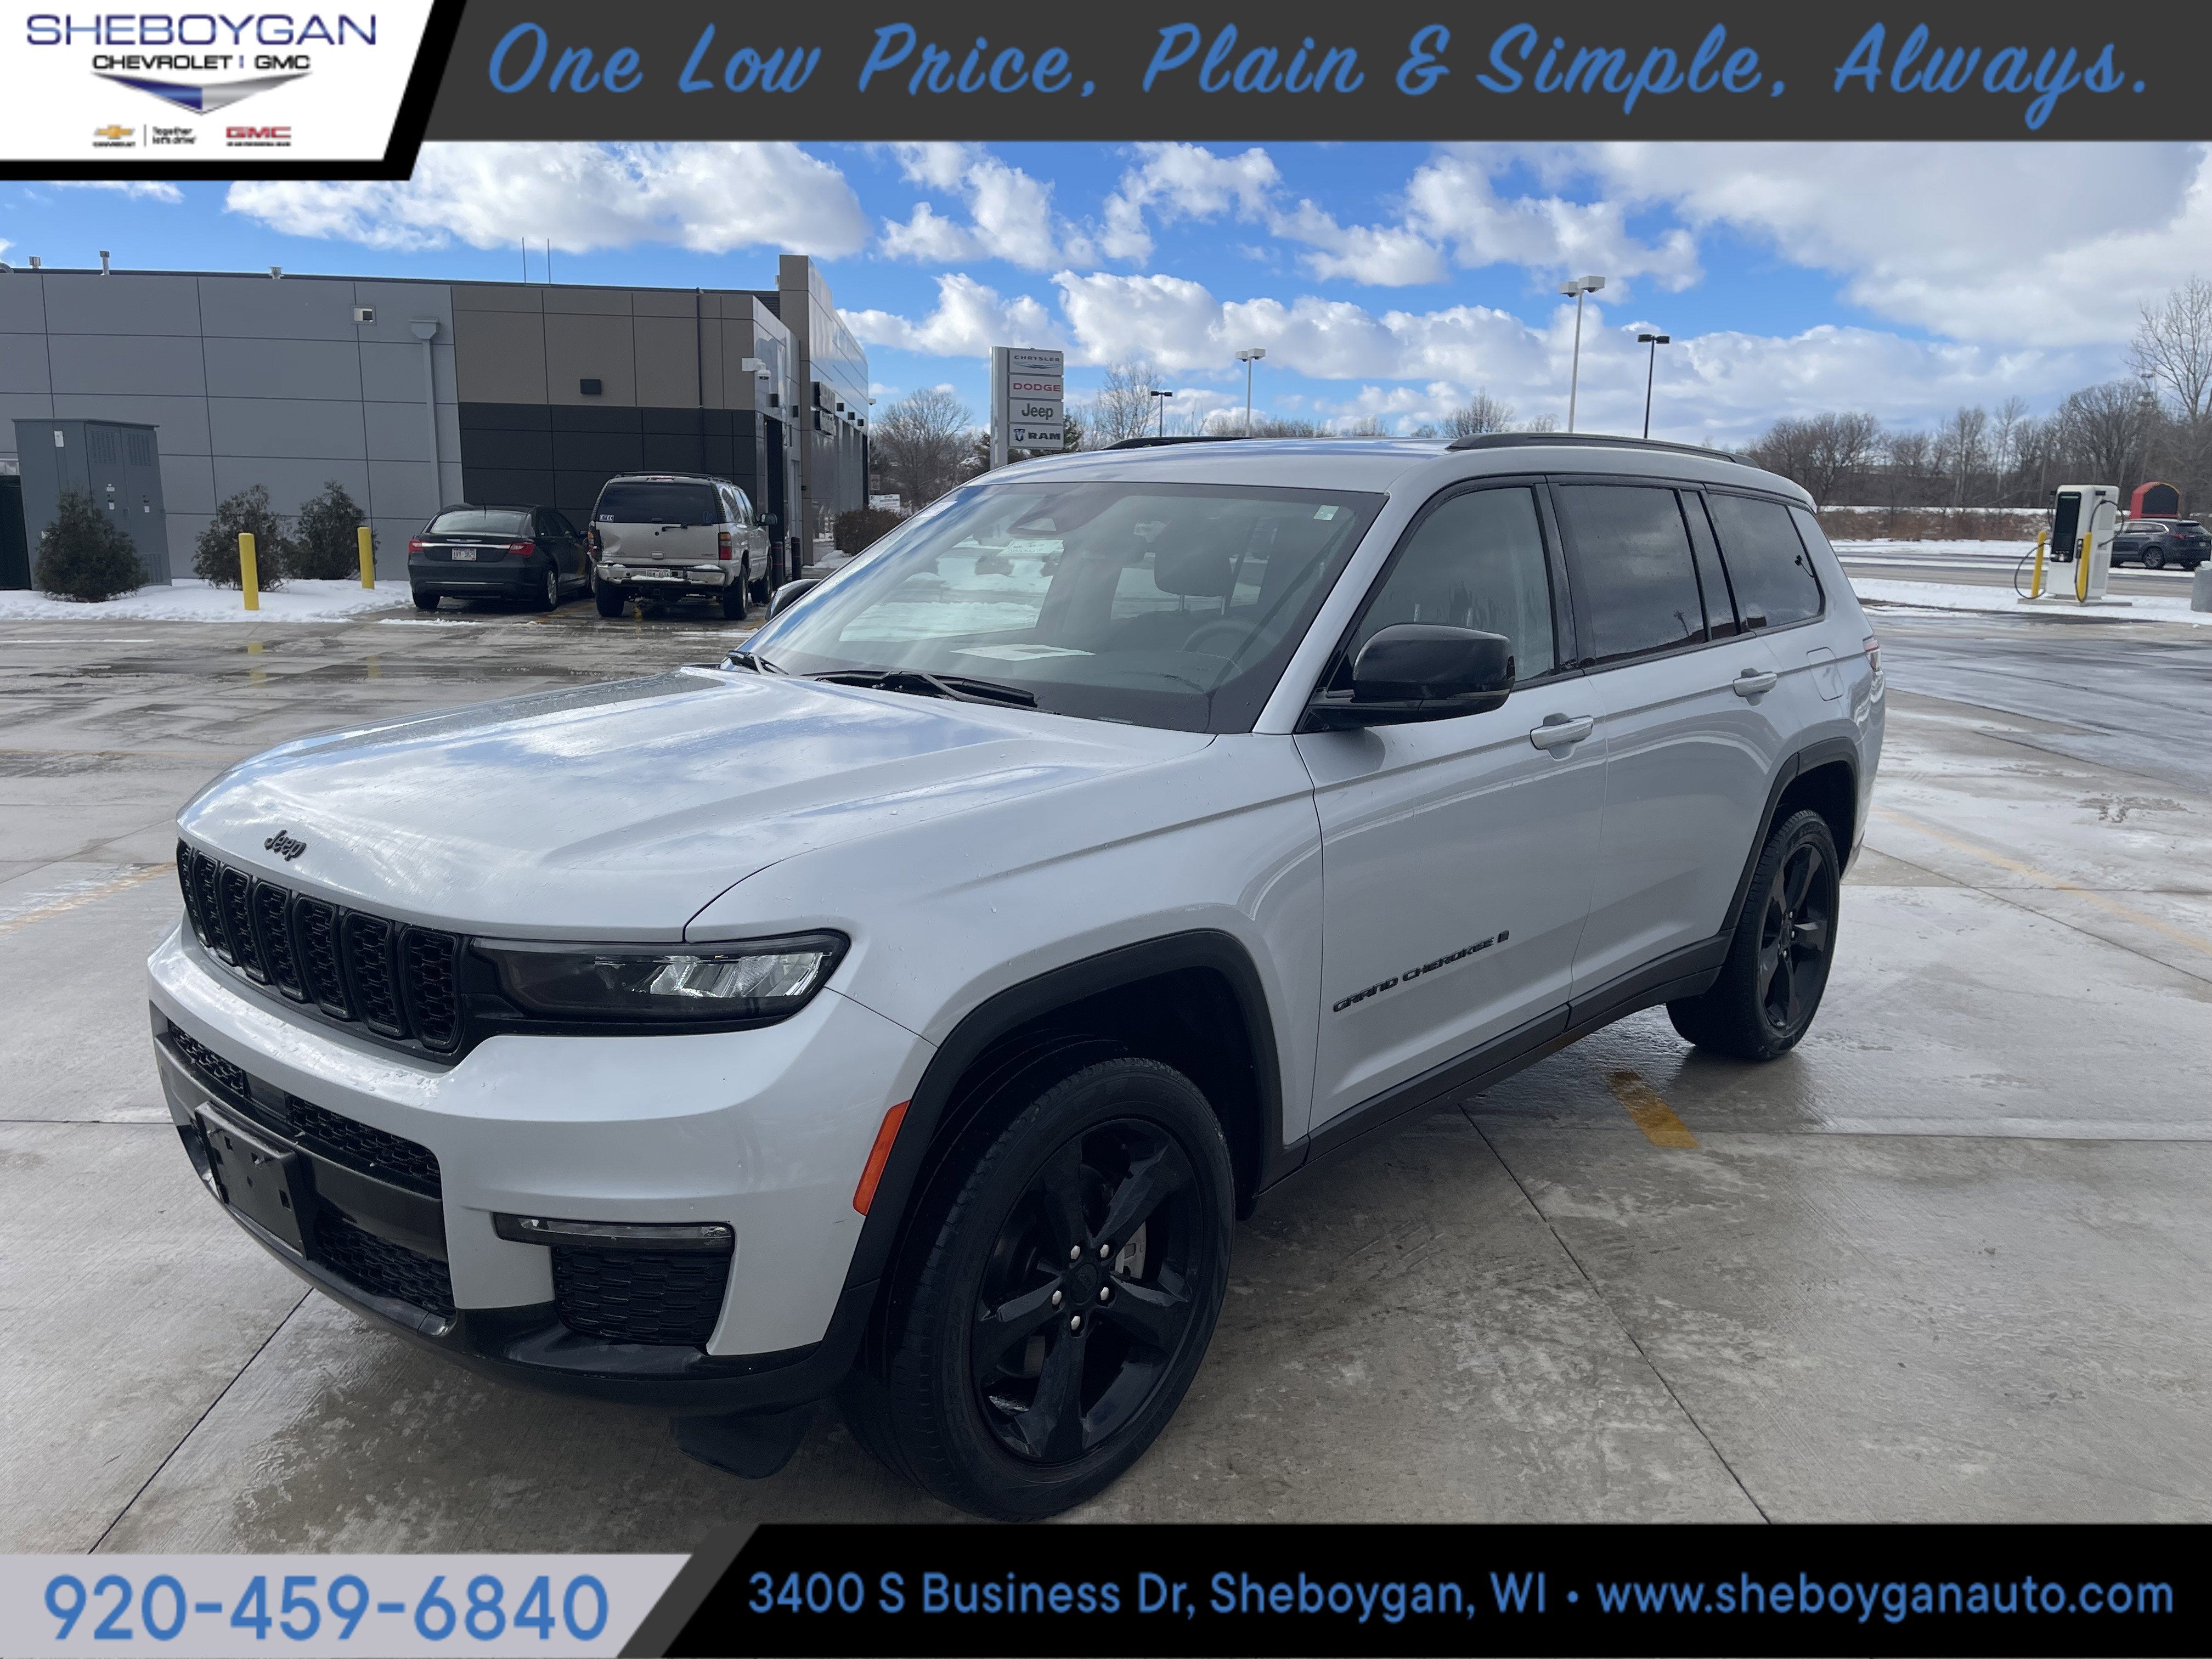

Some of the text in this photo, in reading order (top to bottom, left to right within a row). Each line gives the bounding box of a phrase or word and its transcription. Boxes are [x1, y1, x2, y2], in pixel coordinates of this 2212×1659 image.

[1013, 383, 1061, 392] DODGE
[1022, 403, 1054, 420] Jeep
[264, 830, 307, 861] Jeep
[1334, 977, 1398, 1012] GRAND
[1403, 936, 1494, 981] CHEROKEE
